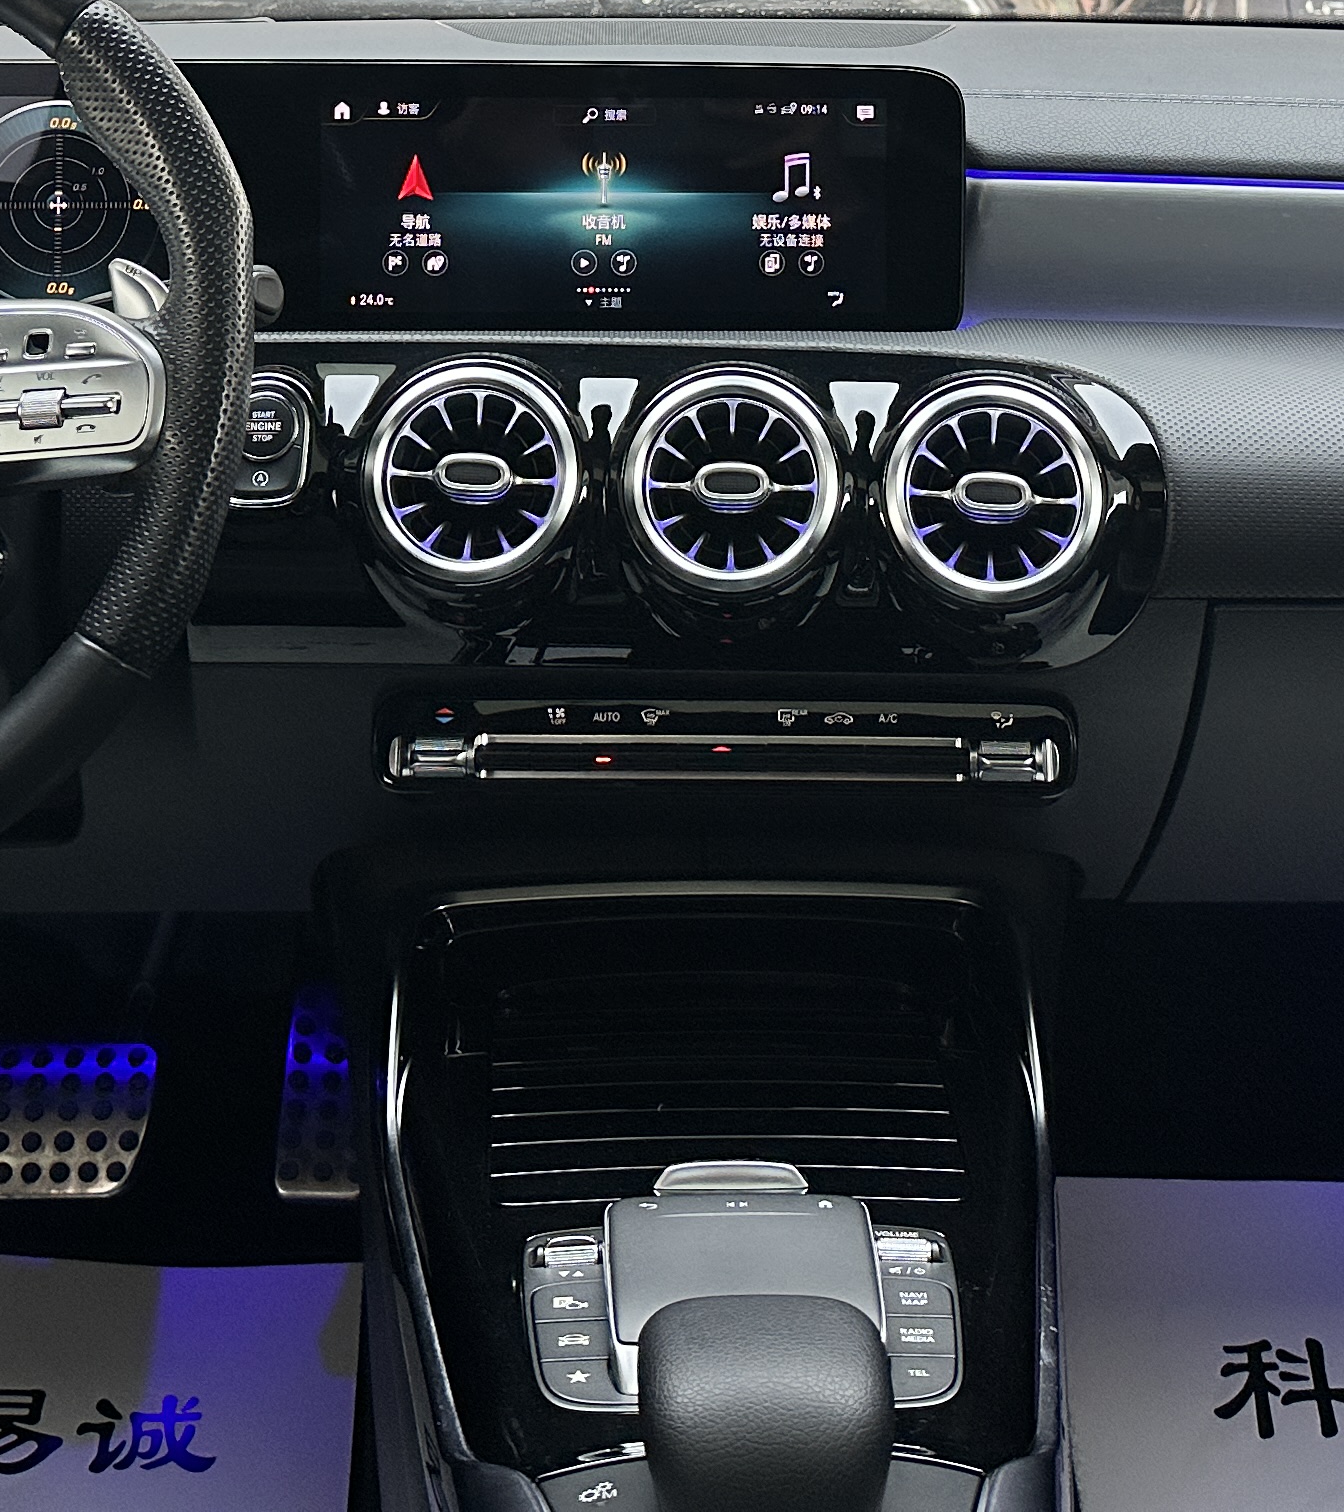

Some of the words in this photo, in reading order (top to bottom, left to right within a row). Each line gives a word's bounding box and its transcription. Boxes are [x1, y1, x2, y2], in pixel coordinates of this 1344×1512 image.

[396, 103, 419, 115] 访客
[800, 104, 828, 115] 09:14
[604, 109, 627, 121] 搜索
[401, 214, 431, 230] 导航
[582, 214, 626, 230] 收音机
[752, 214, 832, 230] 娱乐/多媒体
[389, 233, 442, 247] 无名道路
[595, 234, 612, 246] FM
[760, 233, 824, 248] 无设备连接
[599, 297, 622, 308] 主题
[36, 372, 55, 381] VOL
[252, 410, 275, 419] START
[246, 421, 282, 431] ENGINE
[252, 434, 273, 442] STOP
[592, 711, 621, 722] AUTO
[878, 713, 898, 723] A/C
[874, 1230, 919, 1238] VOLUME
[908, 1369, 931, 1377] TEL
